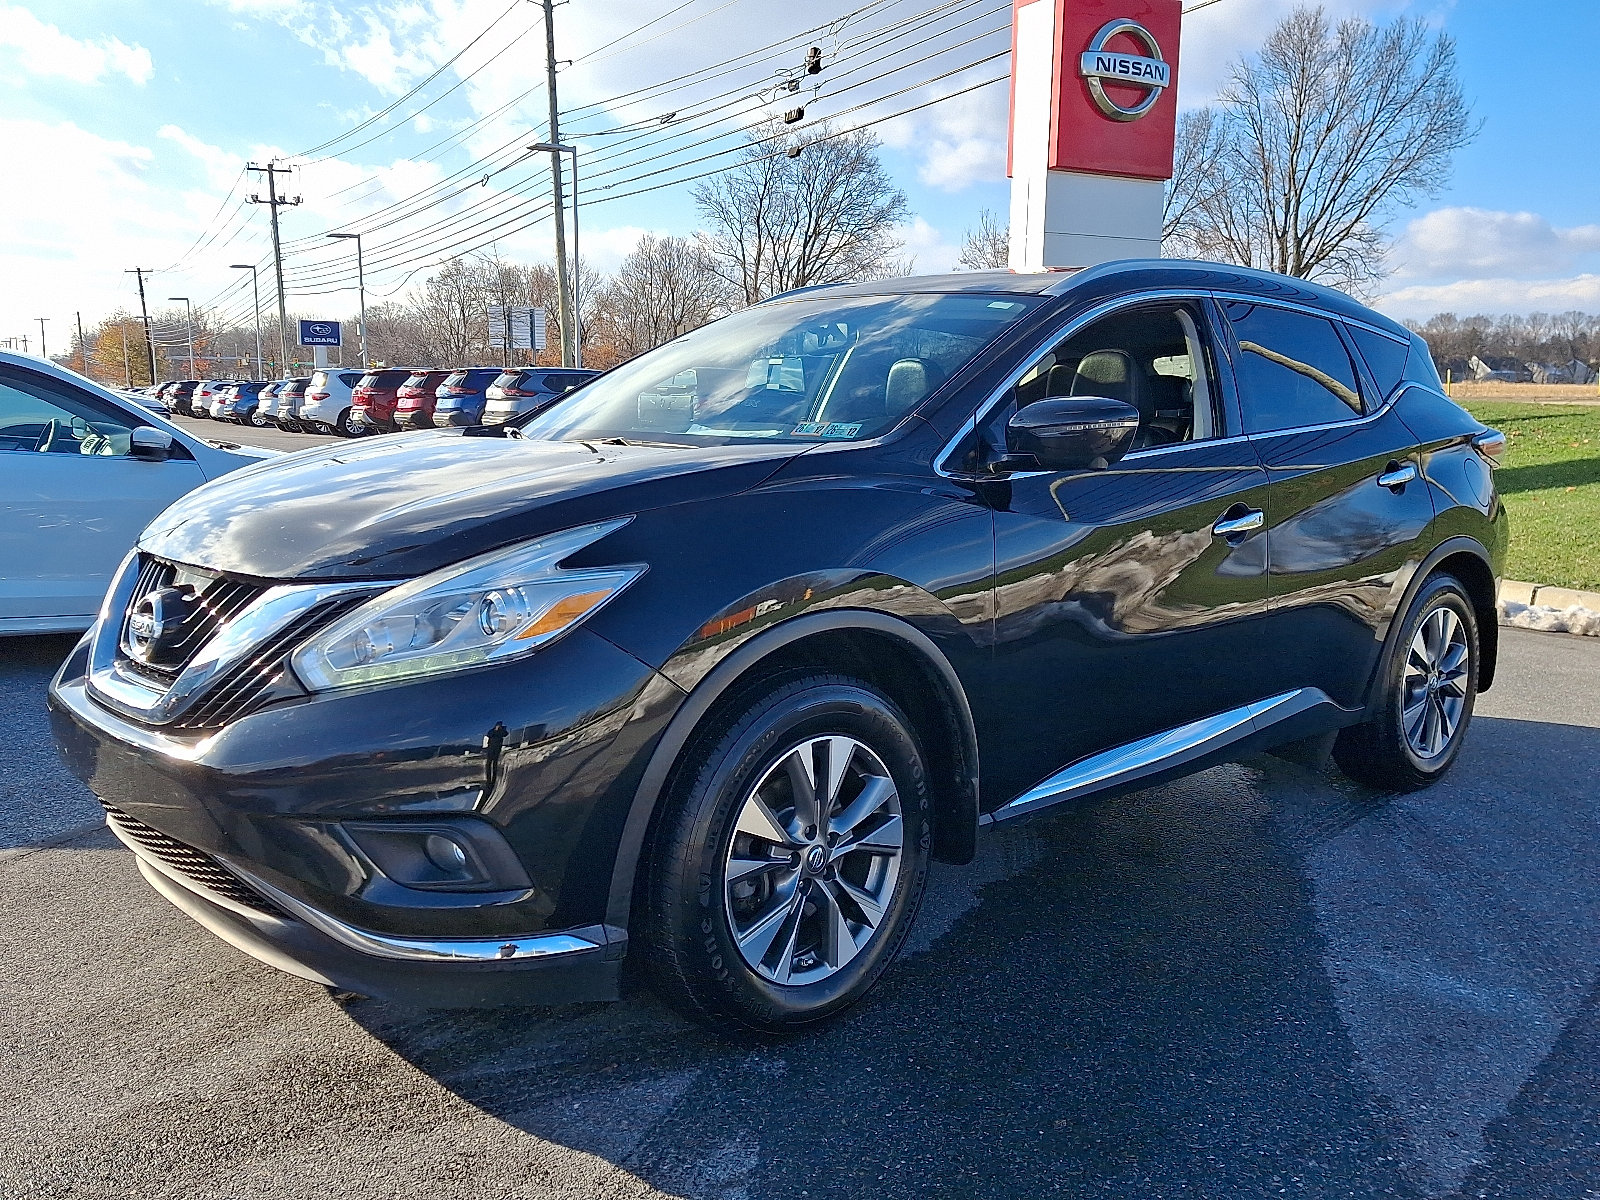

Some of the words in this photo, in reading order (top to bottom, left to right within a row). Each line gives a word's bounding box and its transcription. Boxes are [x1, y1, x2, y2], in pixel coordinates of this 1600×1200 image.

[1096, 57, 1164, 81] NISSAN
[813, 425, 826, 434] 12
[846, 427, 858, 437] 12
